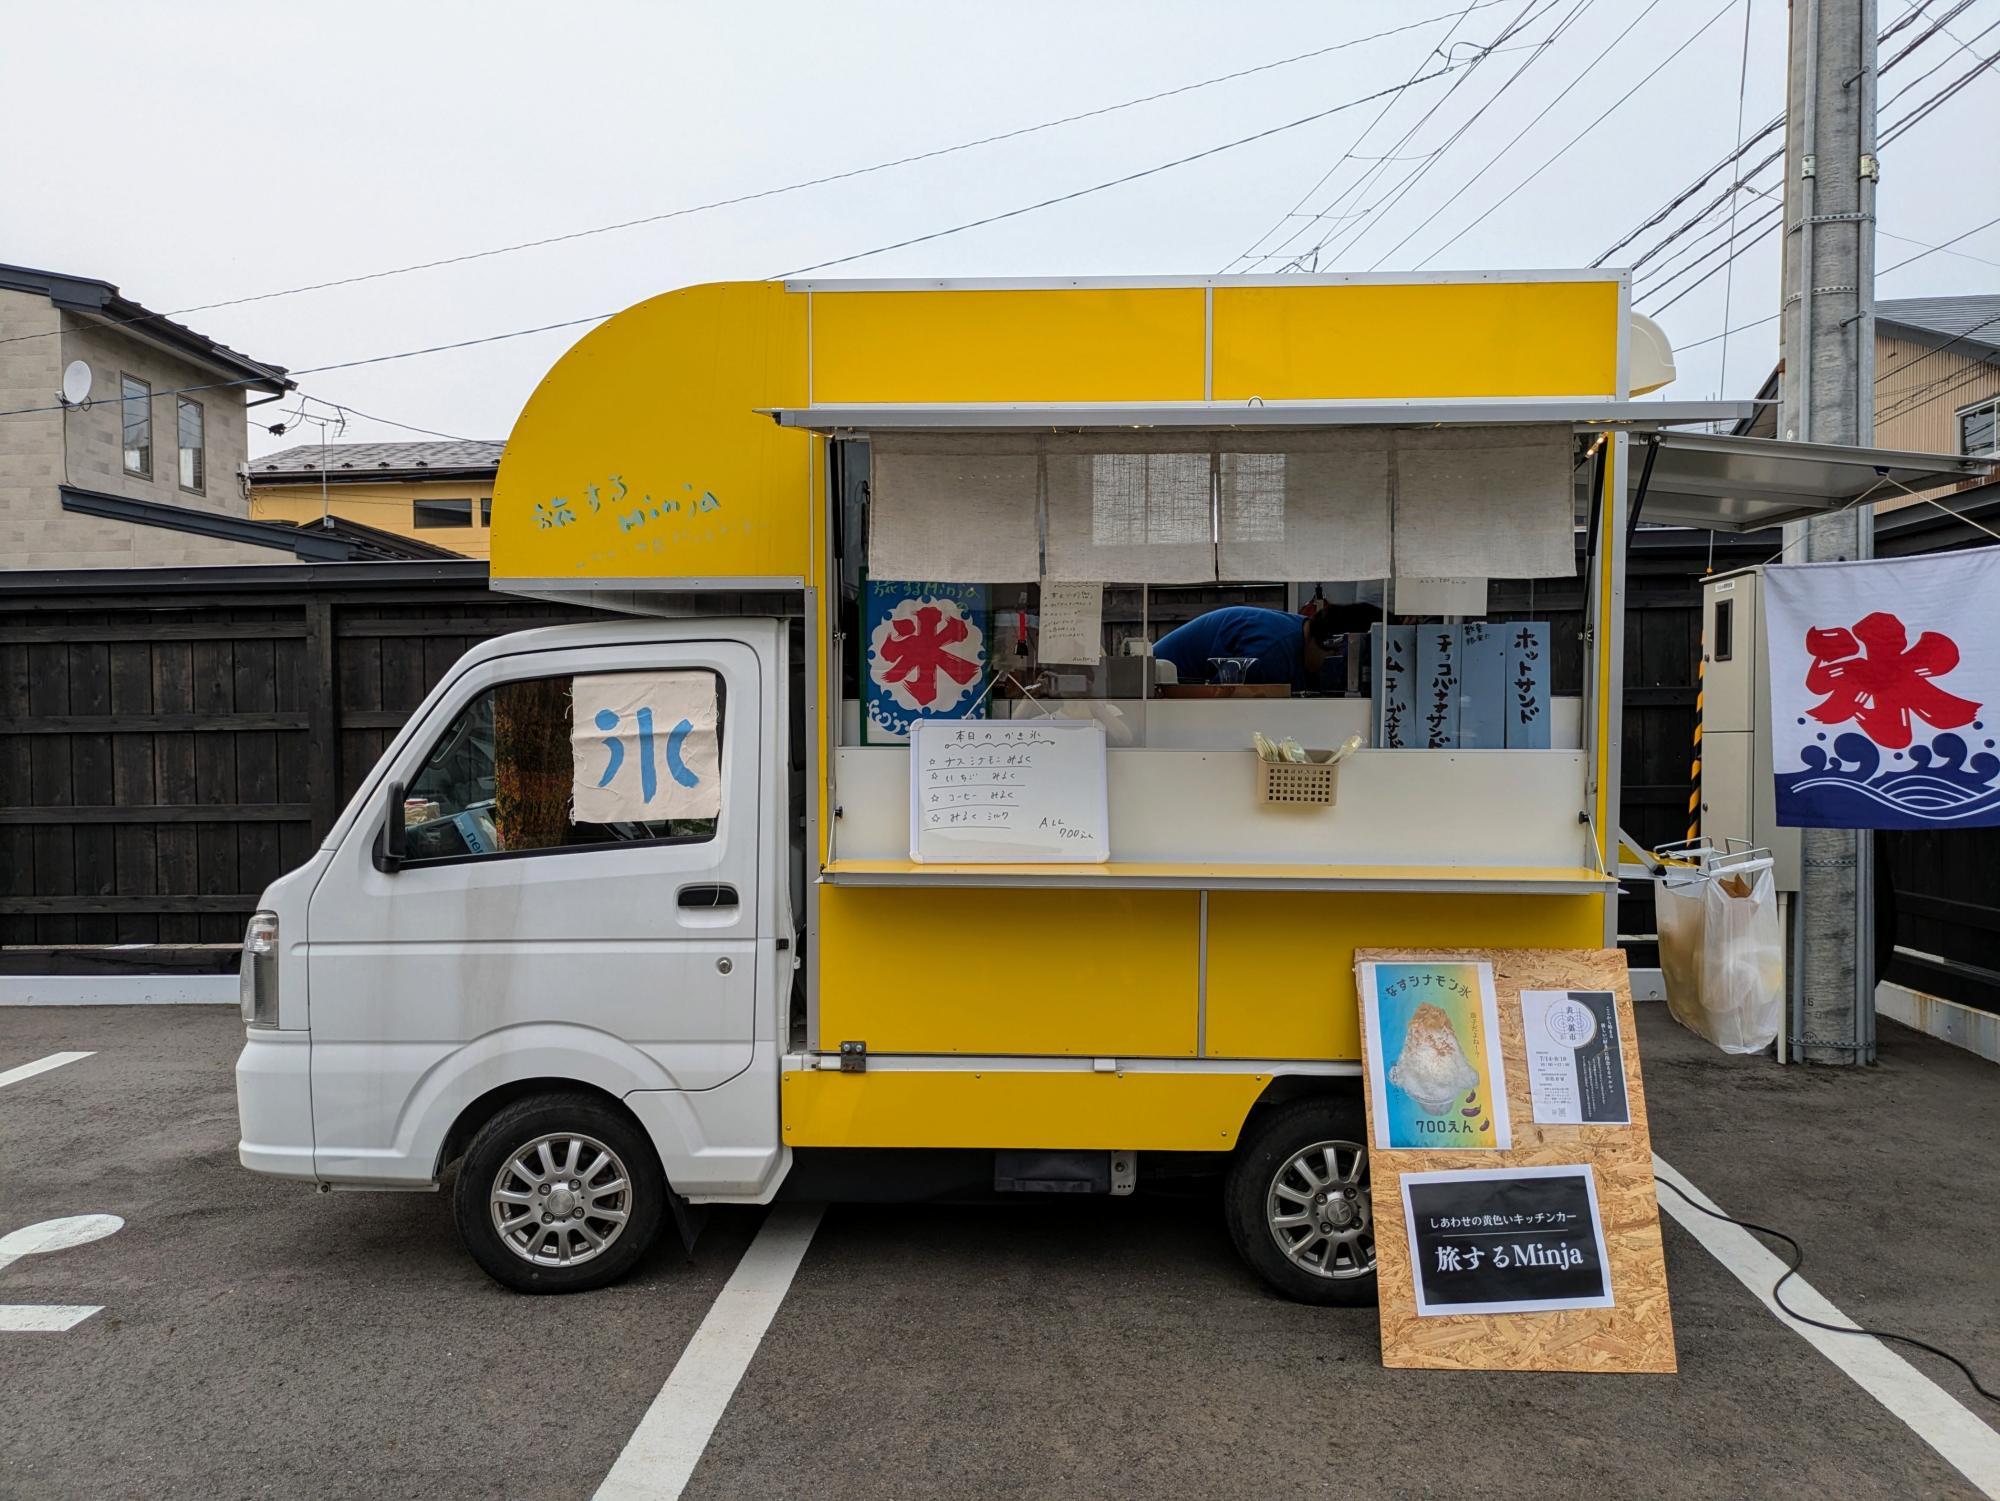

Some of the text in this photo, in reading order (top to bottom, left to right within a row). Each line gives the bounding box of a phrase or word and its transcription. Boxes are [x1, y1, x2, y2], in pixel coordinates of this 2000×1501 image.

[880, 606, 981, 706] 氷
[1514, 626, 1540, 725] ホットサンド
[1804, 612, 1984, 750] 氷
[595, 706, 701, 805] 氷
[1385, 973, 1472, 1000] なすシナモン氷
[1415, 1120, 1474, 1134] 700えん
[1430, 1211, 1577, 1229] しあわせの黄色いキッチンカー
[1434, 1241, 1584, 1273] 旅するMinja
